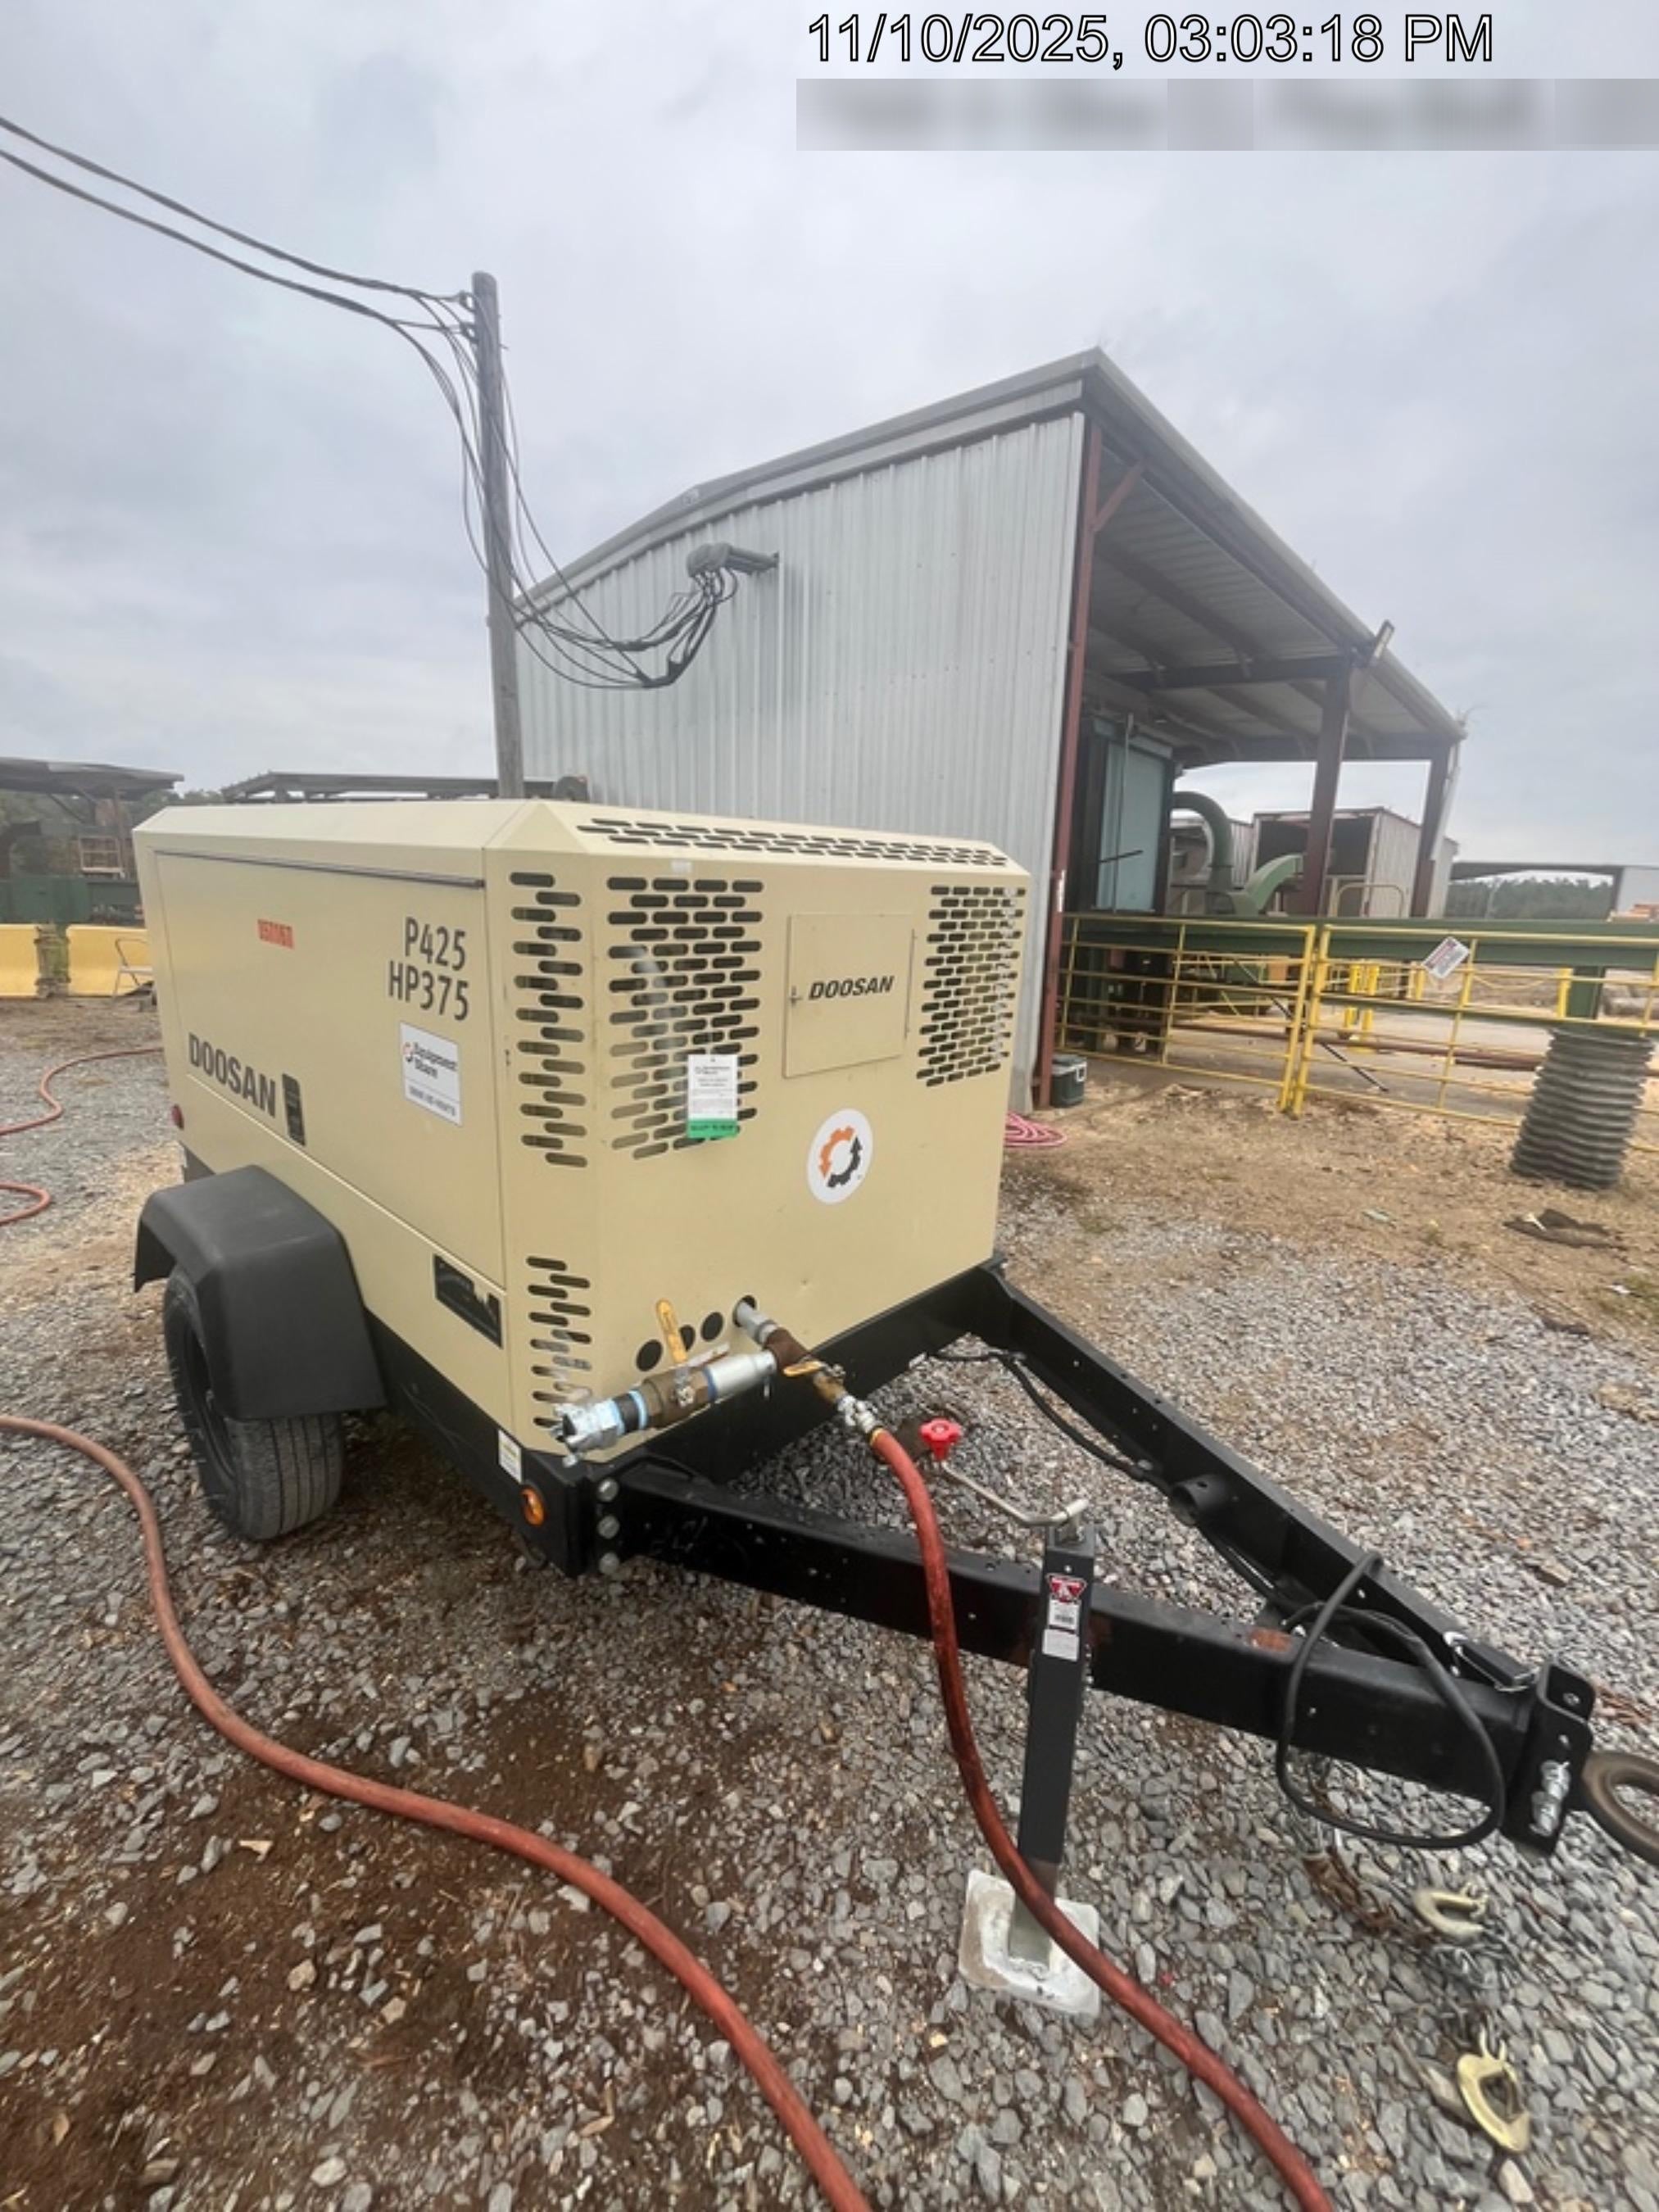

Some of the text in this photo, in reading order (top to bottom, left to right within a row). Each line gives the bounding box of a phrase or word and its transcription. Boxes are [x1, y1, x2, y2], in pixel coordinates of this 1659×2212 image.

[405, 916, 466, 971] P425
[389, 959, 469, 1022] HP375
[809, 975, 895, 1001] DOOSAN
[188, 1032, 276, 1119] DOOSAN
